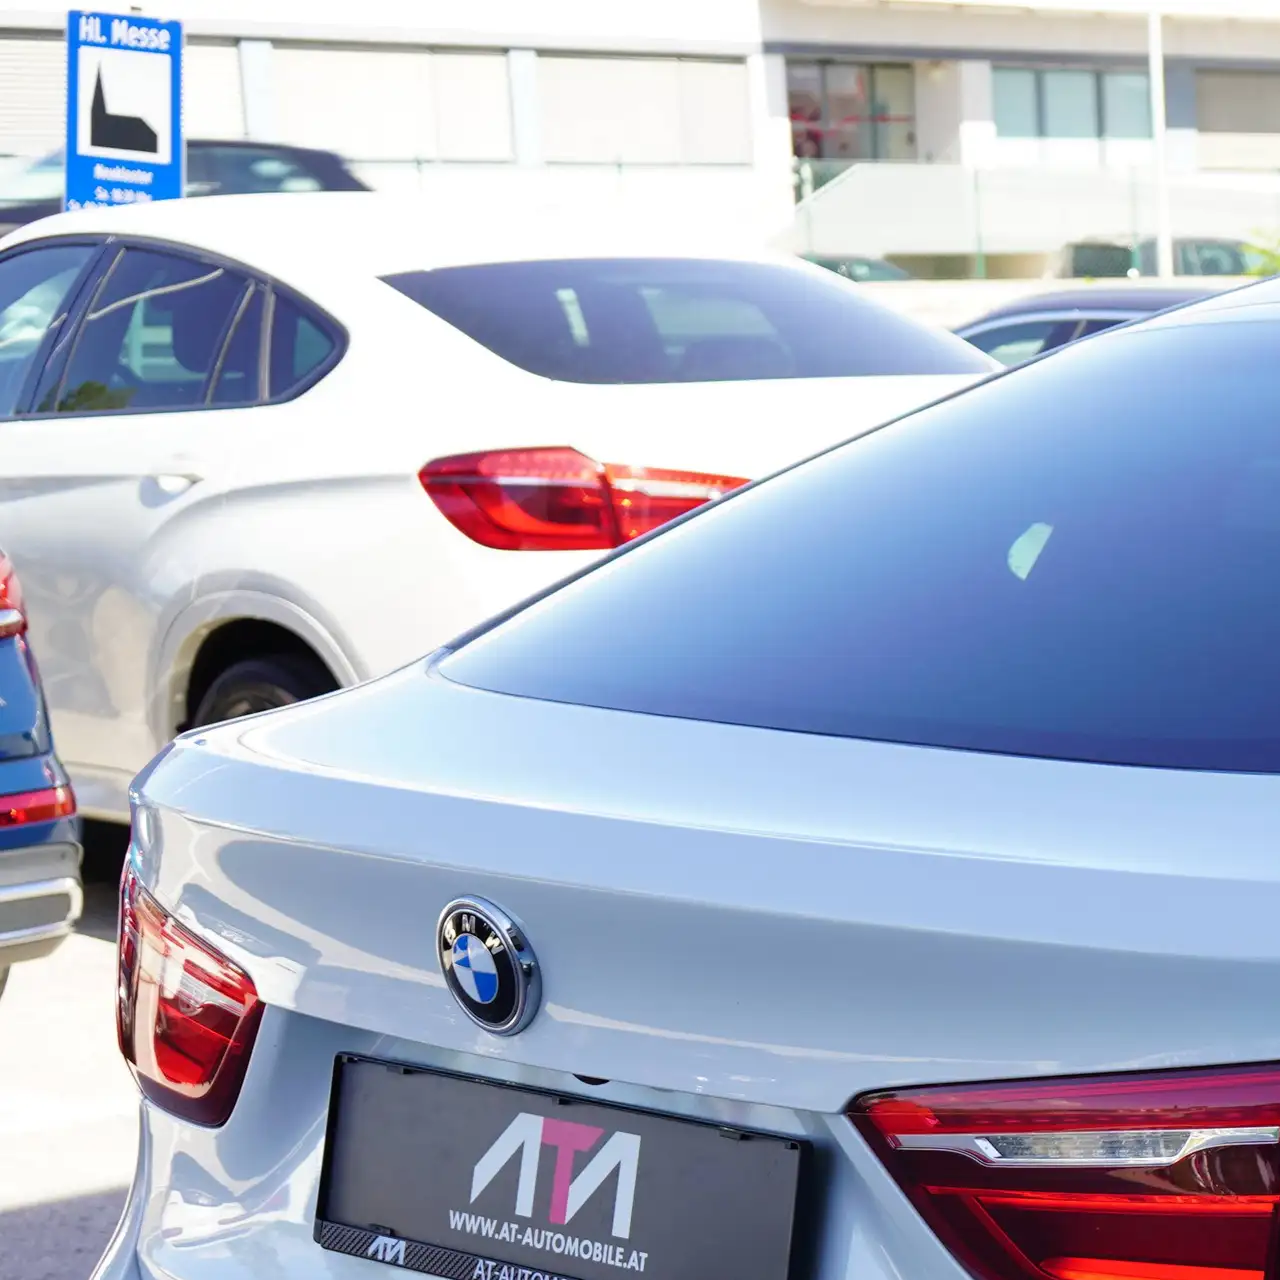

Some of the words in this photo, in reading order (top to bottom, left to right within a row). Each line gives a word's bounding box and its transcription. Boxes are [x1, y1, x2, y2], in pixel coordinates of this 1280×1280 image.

[111, 18, 171, 50] Messe
[444, 914, 505, 955] BMW
[449, 1209, 649, 1272] WWW.AT-AUTOMOBILE.AT
